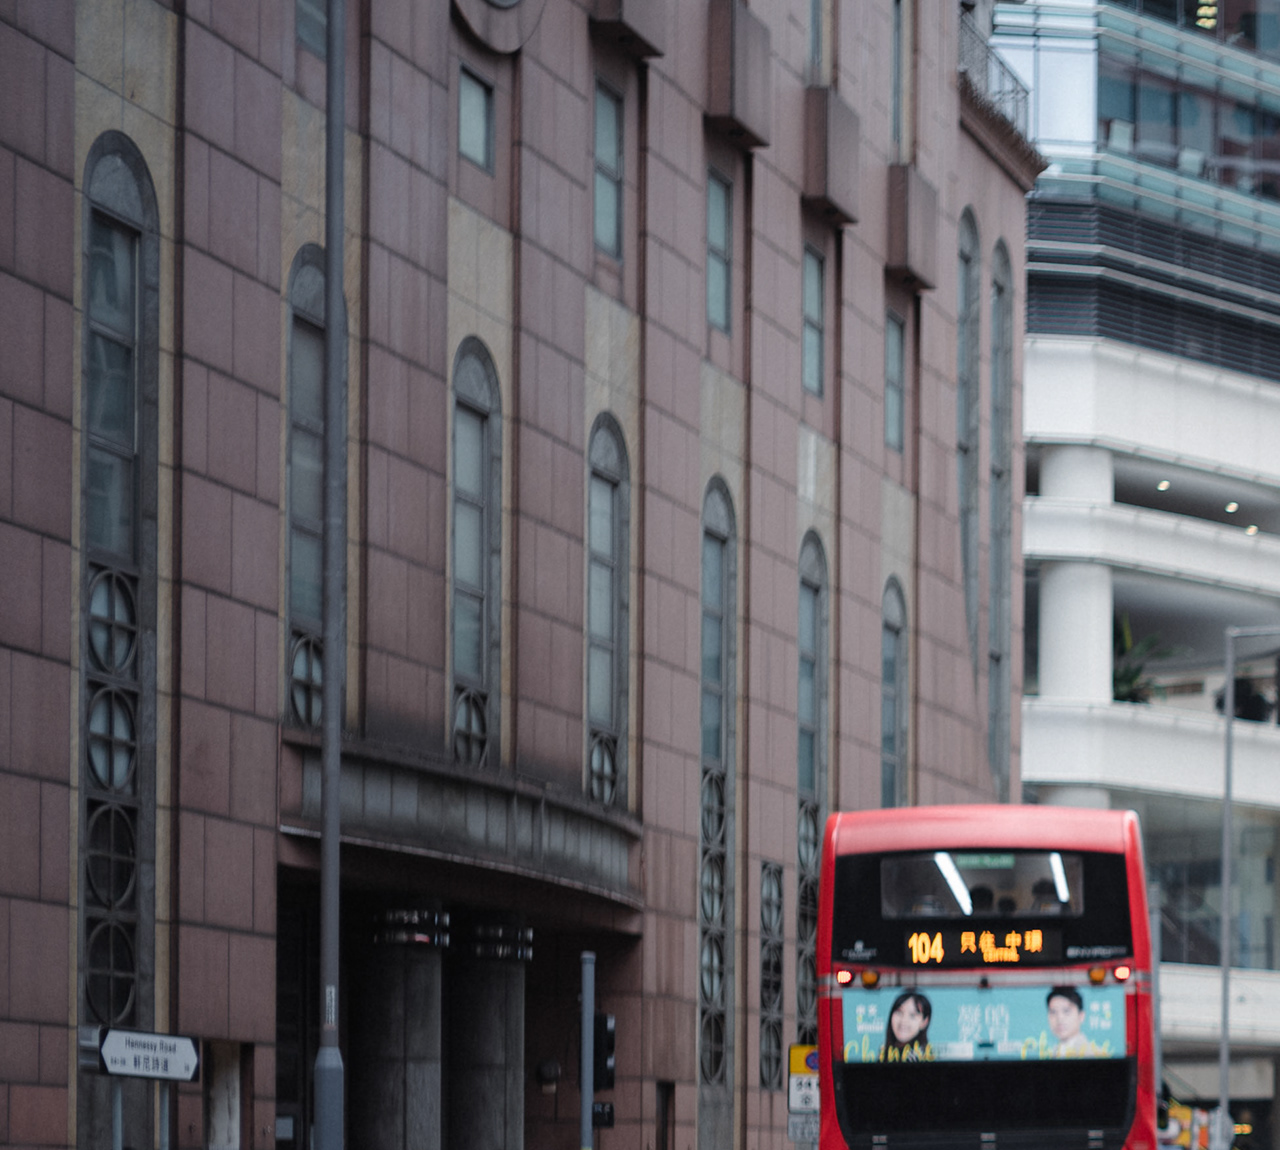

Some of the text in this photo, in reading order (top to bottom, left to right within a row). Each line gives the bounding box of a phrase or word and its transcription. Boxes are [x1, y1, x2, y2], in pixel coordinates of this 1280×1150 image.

[908, 932, 944, 963] 104
[125, 1036, 177, 1055] Hennessy Road
